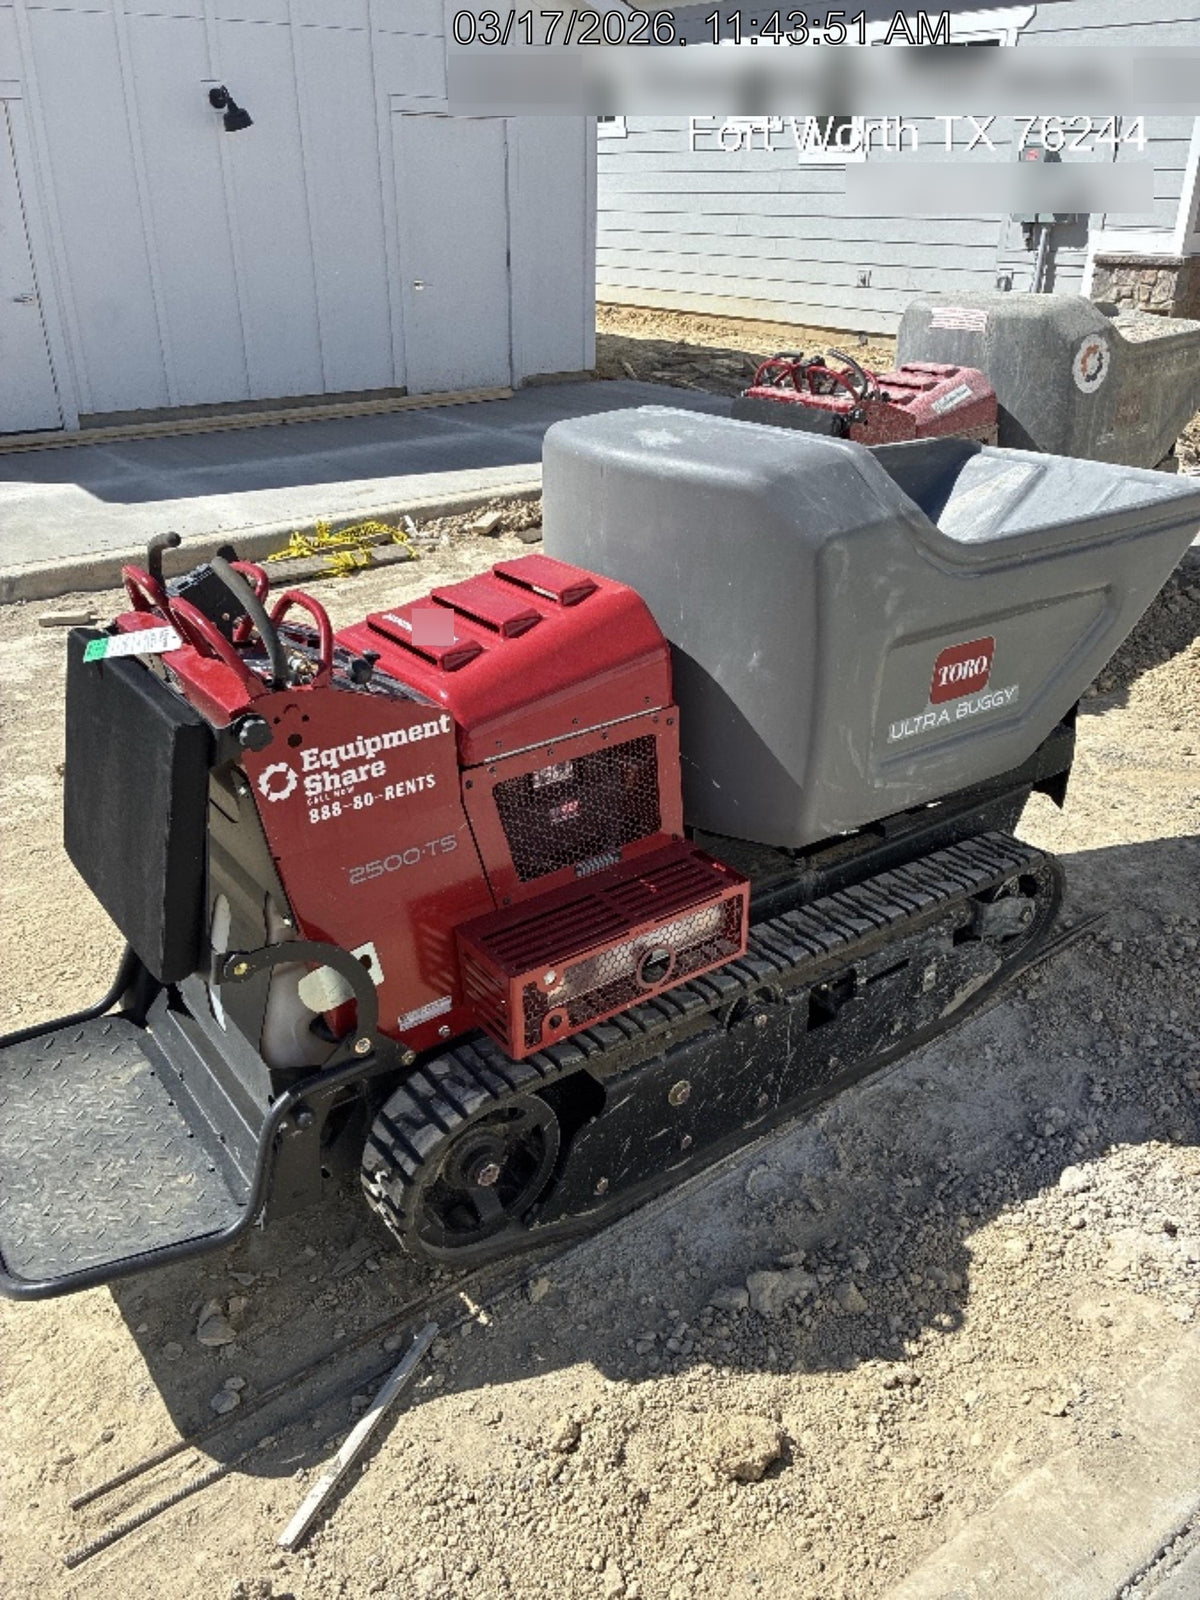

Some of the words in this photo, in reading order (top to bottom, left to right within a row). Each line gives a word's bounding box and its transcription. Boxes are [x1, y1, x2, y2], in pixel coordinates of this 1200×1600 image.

[937, 655, 989, 687] TORO
[890, 708, 950, 740] ULTRA
[956, 684, 1019, 720] BUGGY
[300, 713, 451, 772] Equipment
[303, 760, 386, 797] Share
[307, 793, 330, 807] CALL
